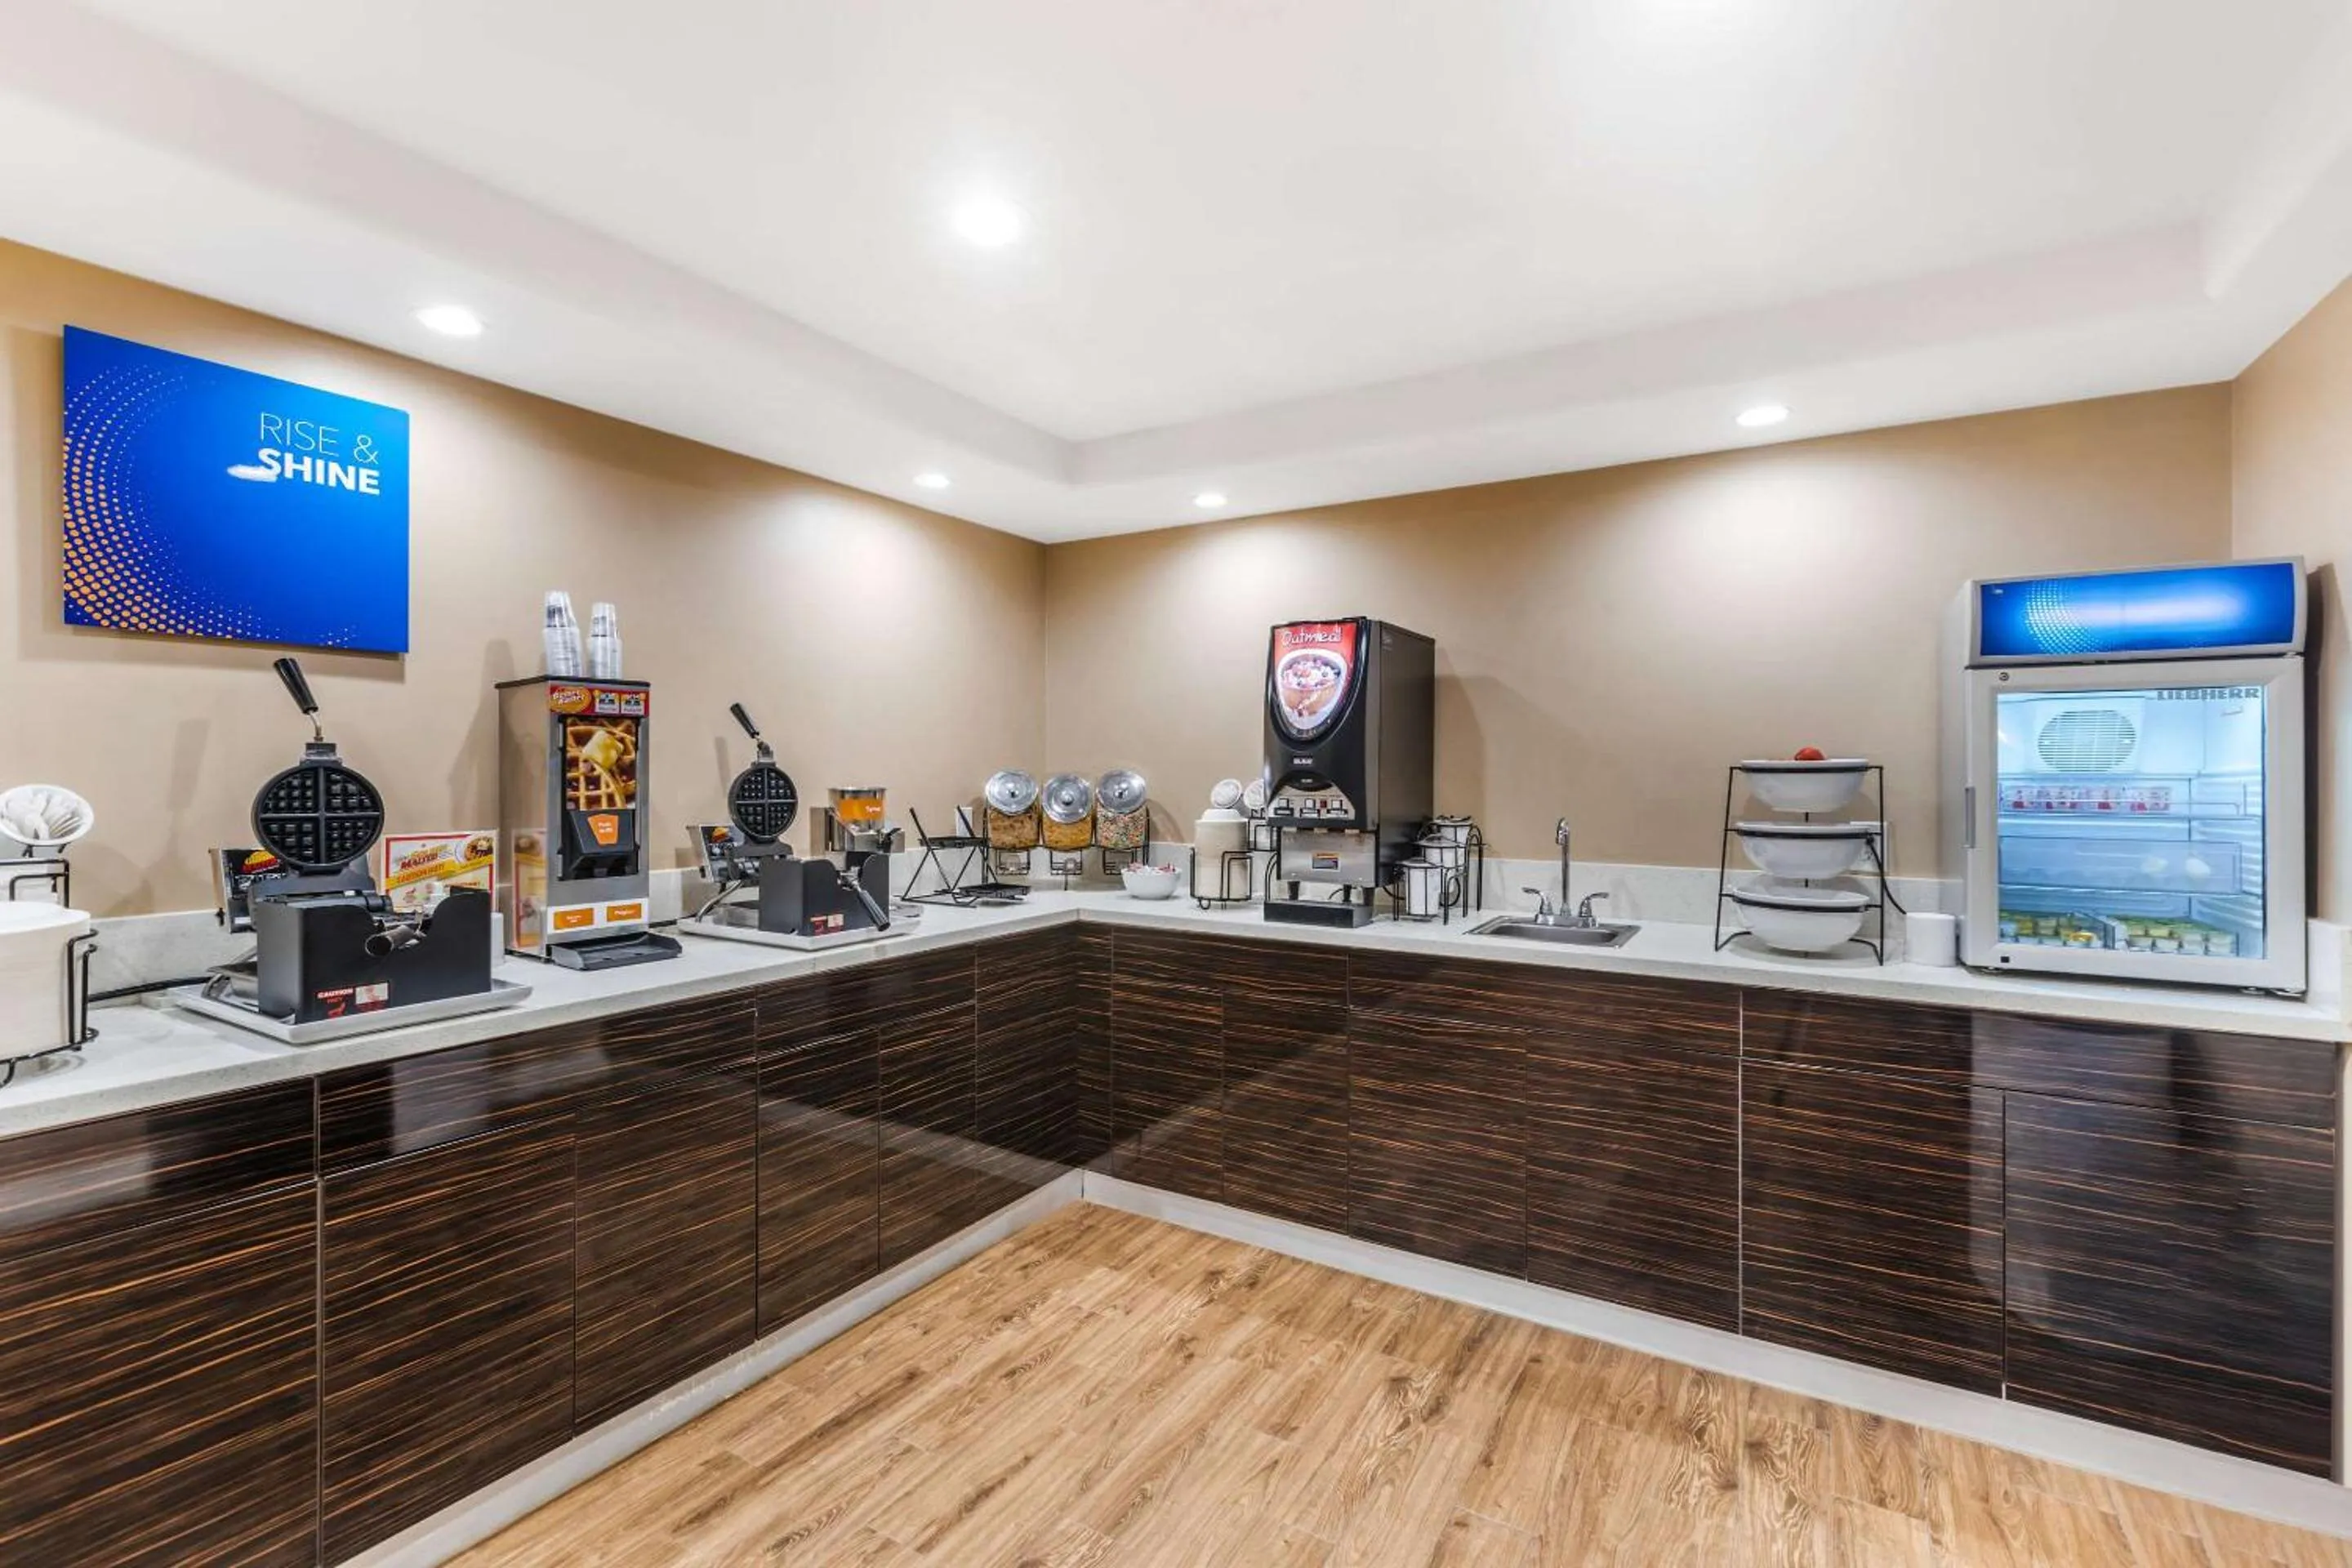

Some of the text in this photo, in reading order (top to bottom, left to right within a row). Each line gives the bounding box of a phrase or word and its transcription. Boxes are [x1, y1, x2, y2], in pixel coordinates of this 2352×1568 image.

[261, 412, 379, 464] RISE &
[258, 448, 380, 496] SHINE
[2157, 688, 2260, 701] LIEBHERR
